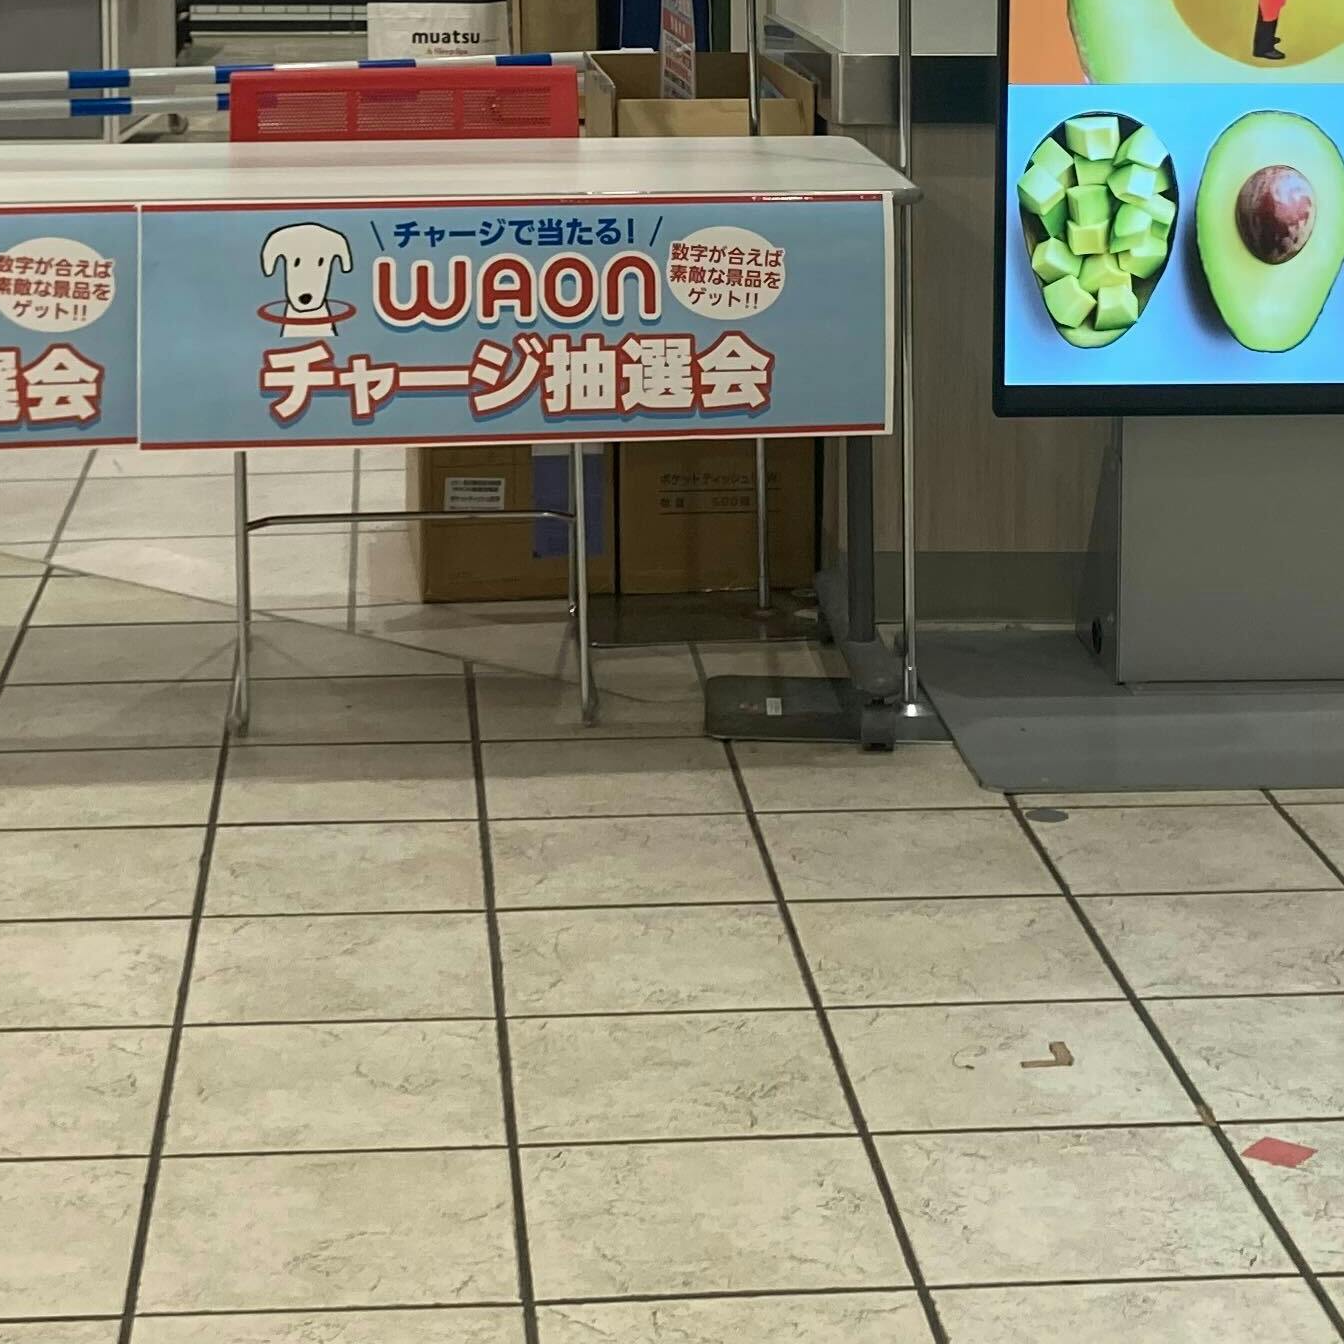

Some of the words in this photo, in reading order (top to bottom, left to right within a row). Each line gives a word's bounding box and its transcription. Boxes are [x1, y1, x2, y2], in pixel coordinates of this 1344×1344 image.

[412, 29, 481, 45] muatsu
[671, 242, 784, 268] 数字が合えば
[377, 254, 659, 323] WAON
[669, 264, 782, 290] 素敵な景品を
[263, 332, 774, 423] チャージ抽選会
